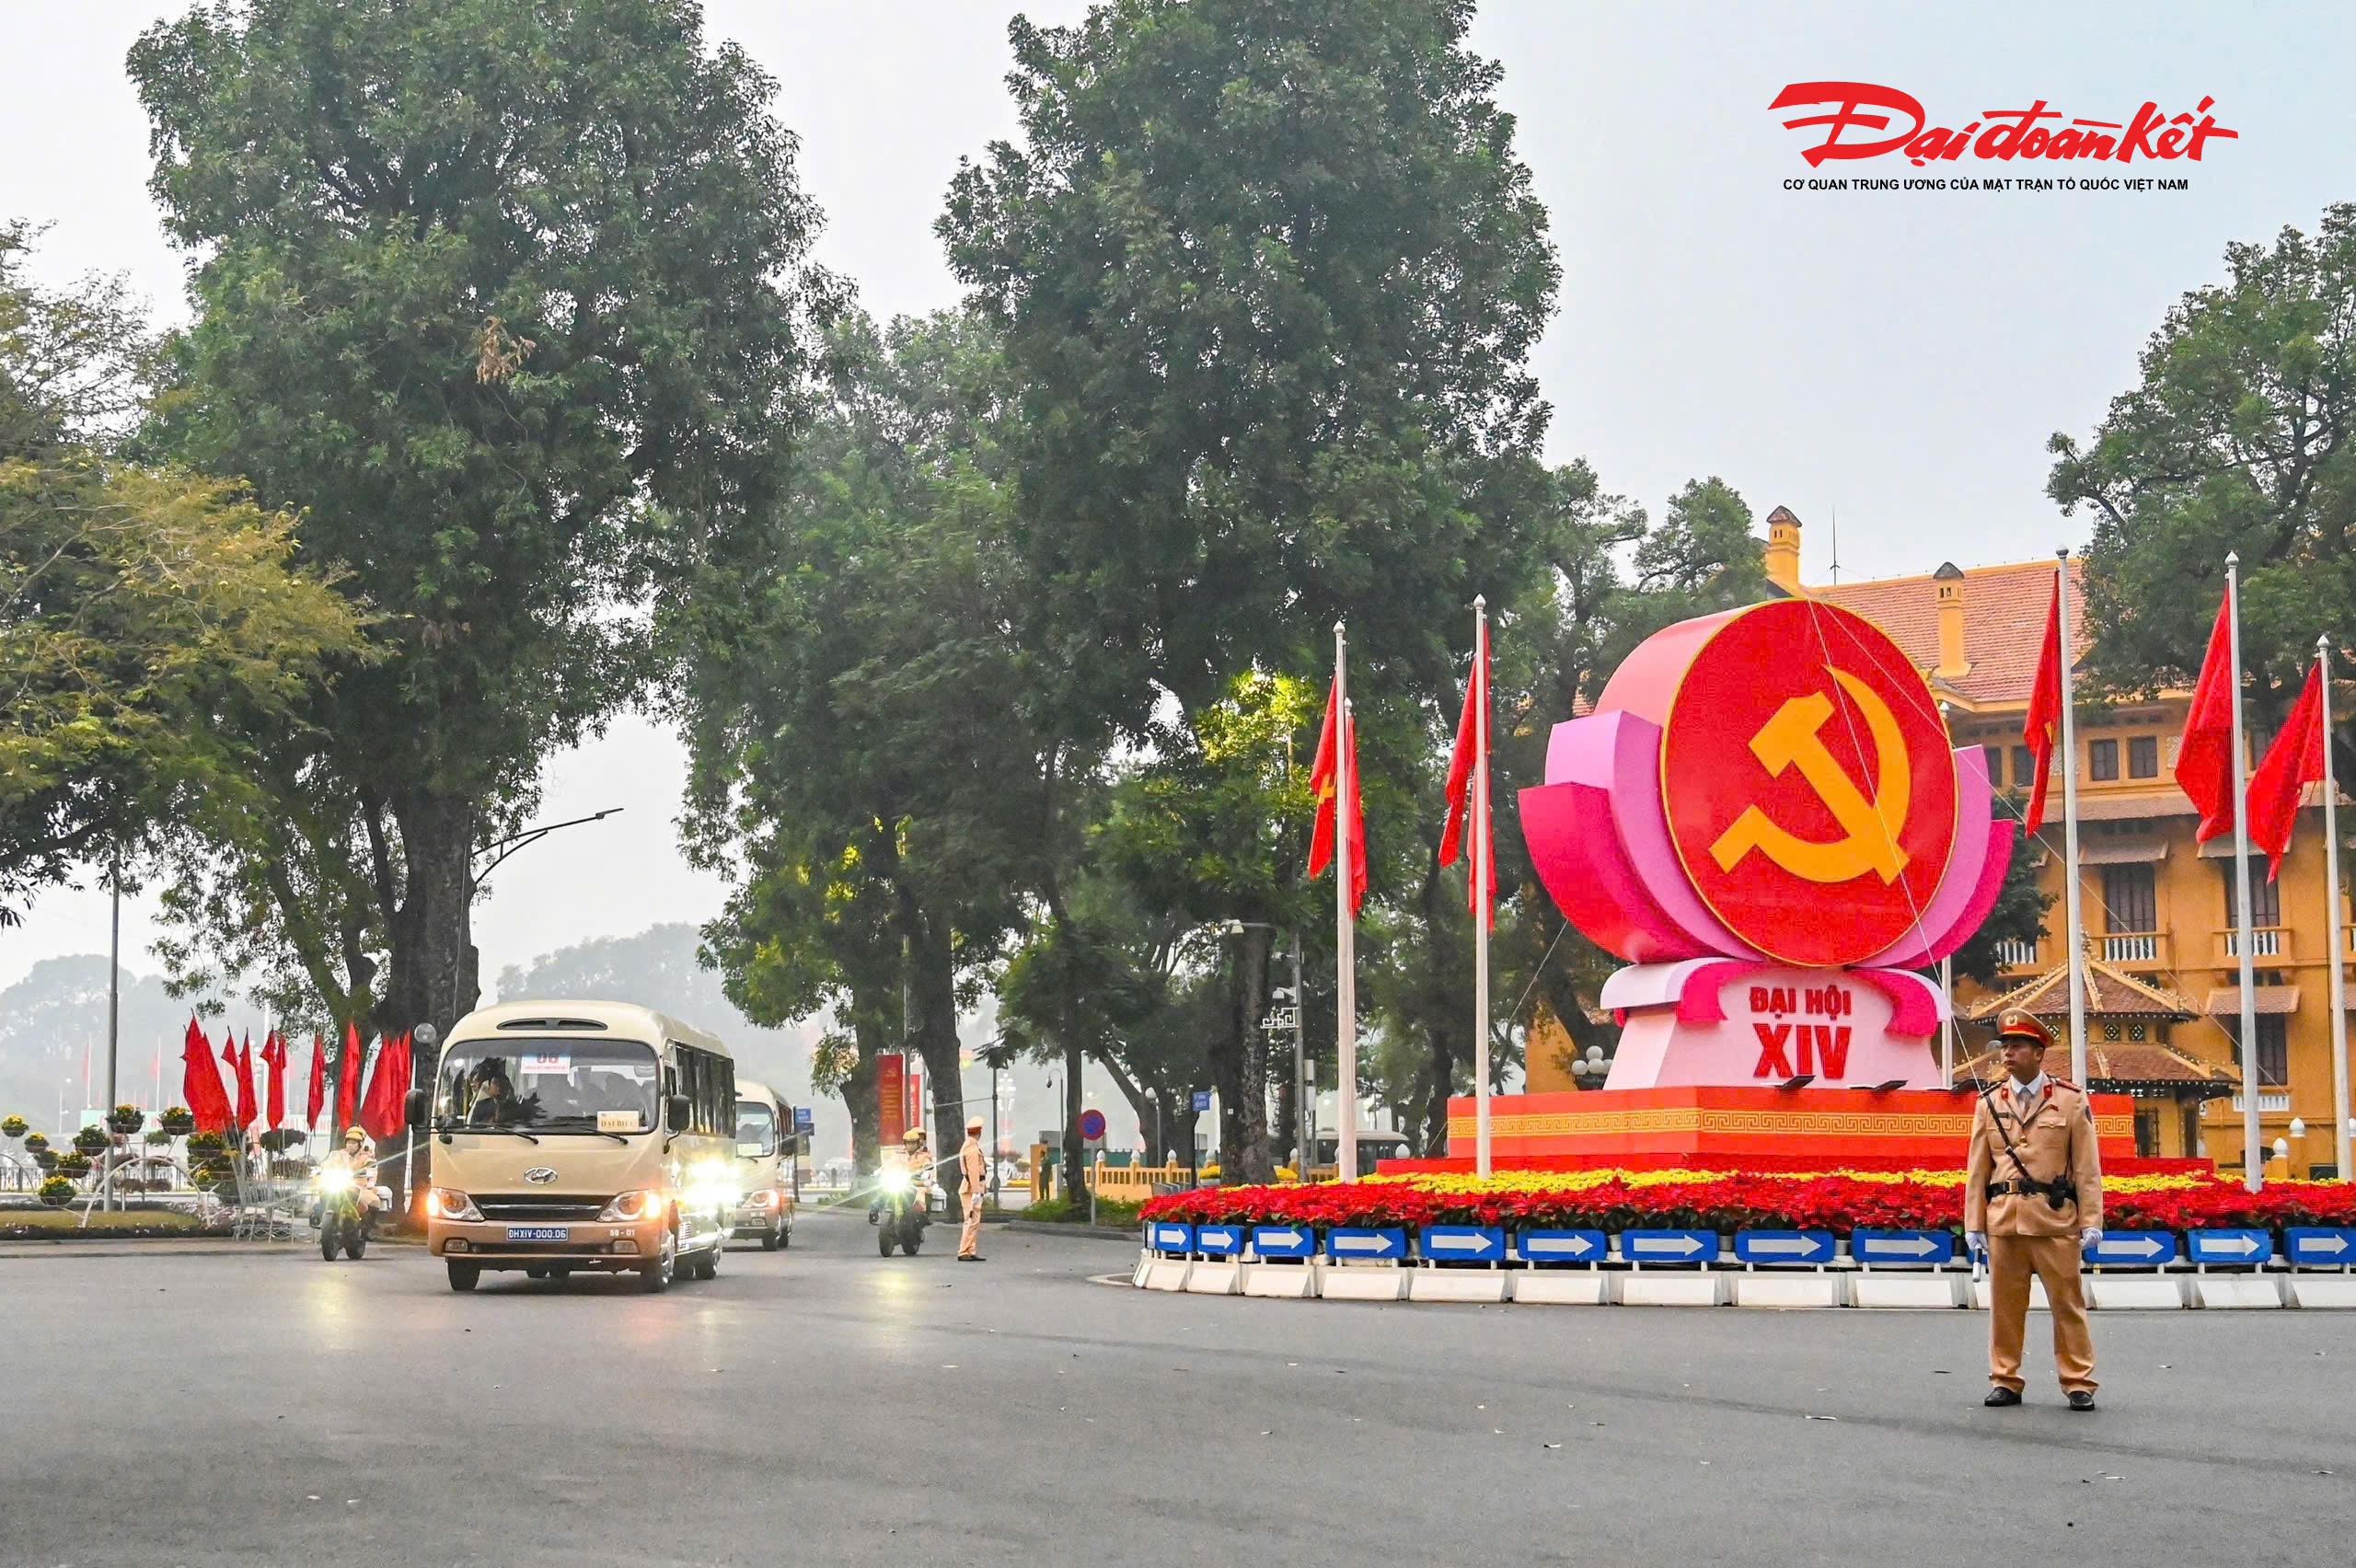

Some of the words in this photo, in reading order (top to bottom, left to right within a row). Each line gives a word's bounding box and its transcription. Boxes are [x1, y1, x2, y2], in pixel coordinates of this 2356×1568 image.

[1749, 986, 1796, 1020] ĐẠI
[1805, 984, 1852, 1021] HỘI
[1752, 1022, 1852, 1080] XIV
